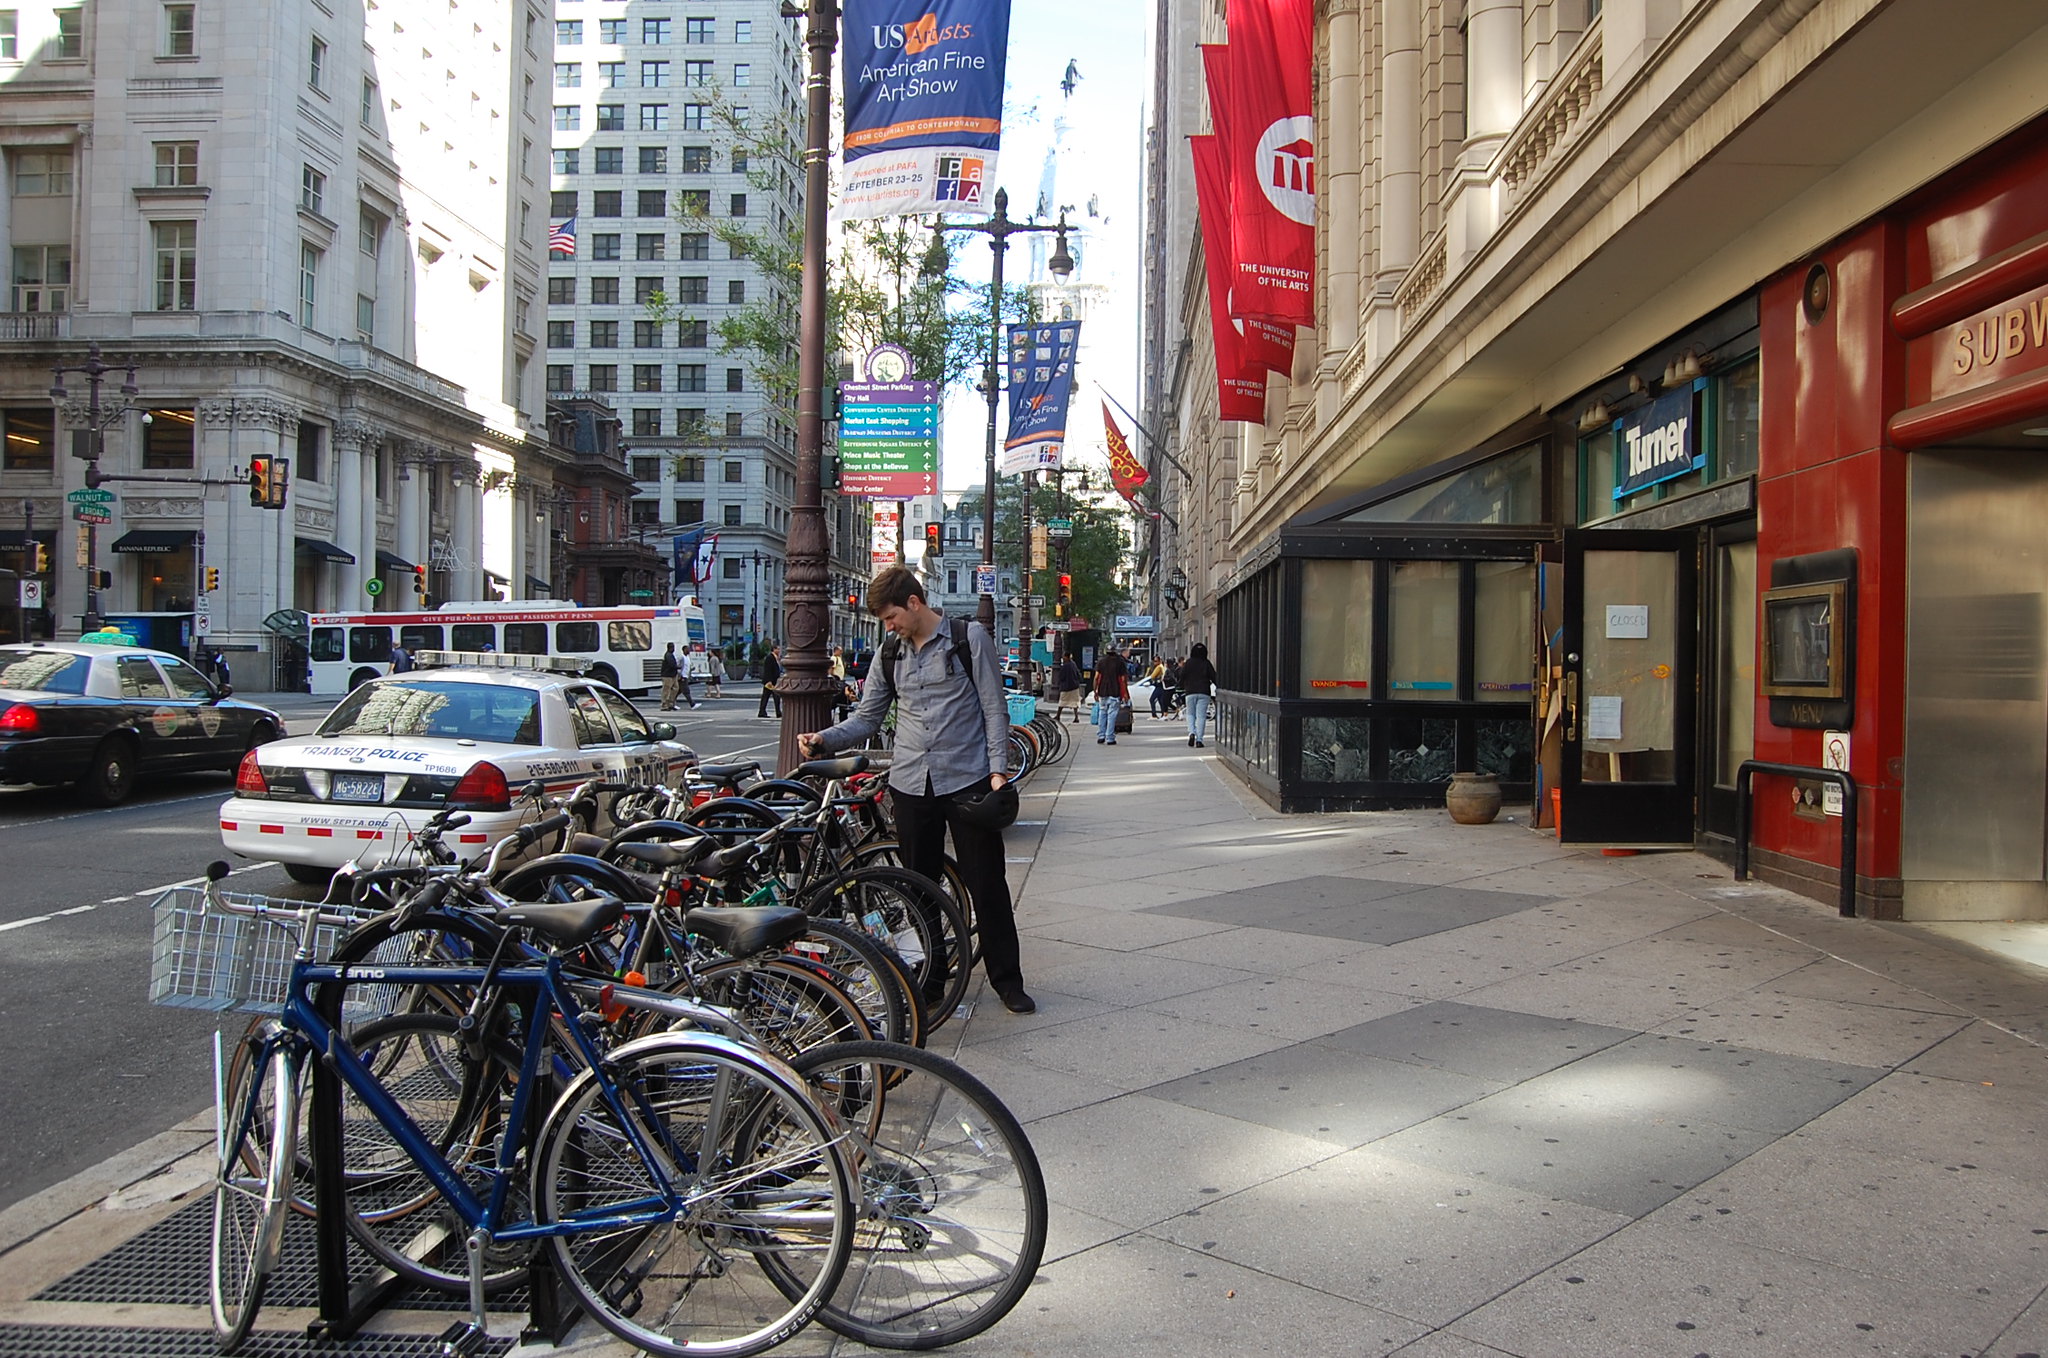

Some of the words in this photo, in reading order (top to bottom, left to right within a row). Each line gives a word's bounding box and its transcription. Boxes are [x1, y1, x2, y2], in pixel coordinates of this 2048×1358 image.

[859, 57, 939, 83] American
[943, 51, 985, 71] Fine
[876, 83, 907, 103] Art
[906, 78, 958, 98] Show
[856, 133, 872, 142] FROM
[873, 127, 904, 139] COLONIAL
[906, 123, 916, 132] TO
[917, 120, 980, 130] CONTEMPORARY
[895, 161, 917, 171] PAFA
[1240, 263, 1258, 273] THE
[1260, 265, 1309, 281] UNIVERSITY
[1258, 276, 1270, 286] OF
[1271, 278, 1287, 289] THE
[1288, 281, 1309, 292] ARTS
[1249, 319, 1262, 329] THE
[1263, 321, 1292, 340] UNIVERSITY
[1262, 332, 1270, 341] OF
[1271, 335, 1281, 345] THE
[890, 384, 914, 392] Parking
[1236, 387, 1244, 395] OF
[1244, 389, 1254, 397] THE
[843, 395, 857, 403] City
[857, 394, 870, 402] Hall
[1041, 405, 1058, 414] Fine
[843, 417, 865, 425] Market
[866, 417, 879, 425] East
[880, 417, 910, 426] Shopping
[1626, 416, 1687, 477] Turner
[843, 463, 862, 471] Shops
[69, 494, 102, 502] WALNUT
[85, 507, 105, 517] BROAD
[1610, 614, 1646, 627] CLOSED
[1792, 703, 1825, 723] MENU
[301, 747, 369, 757] TRANSIT
[367, 748, 429, 762] POLICE
[424, 763, 457, 774] TP1686
[526, 760, 580, 777] 215-580-8111
[335, 780, 380, 795] MG-5822E
[300, 815, 390, 828] WWW.SEPTA.ORG
[770, 1297, 822, 1345] SERFAS
